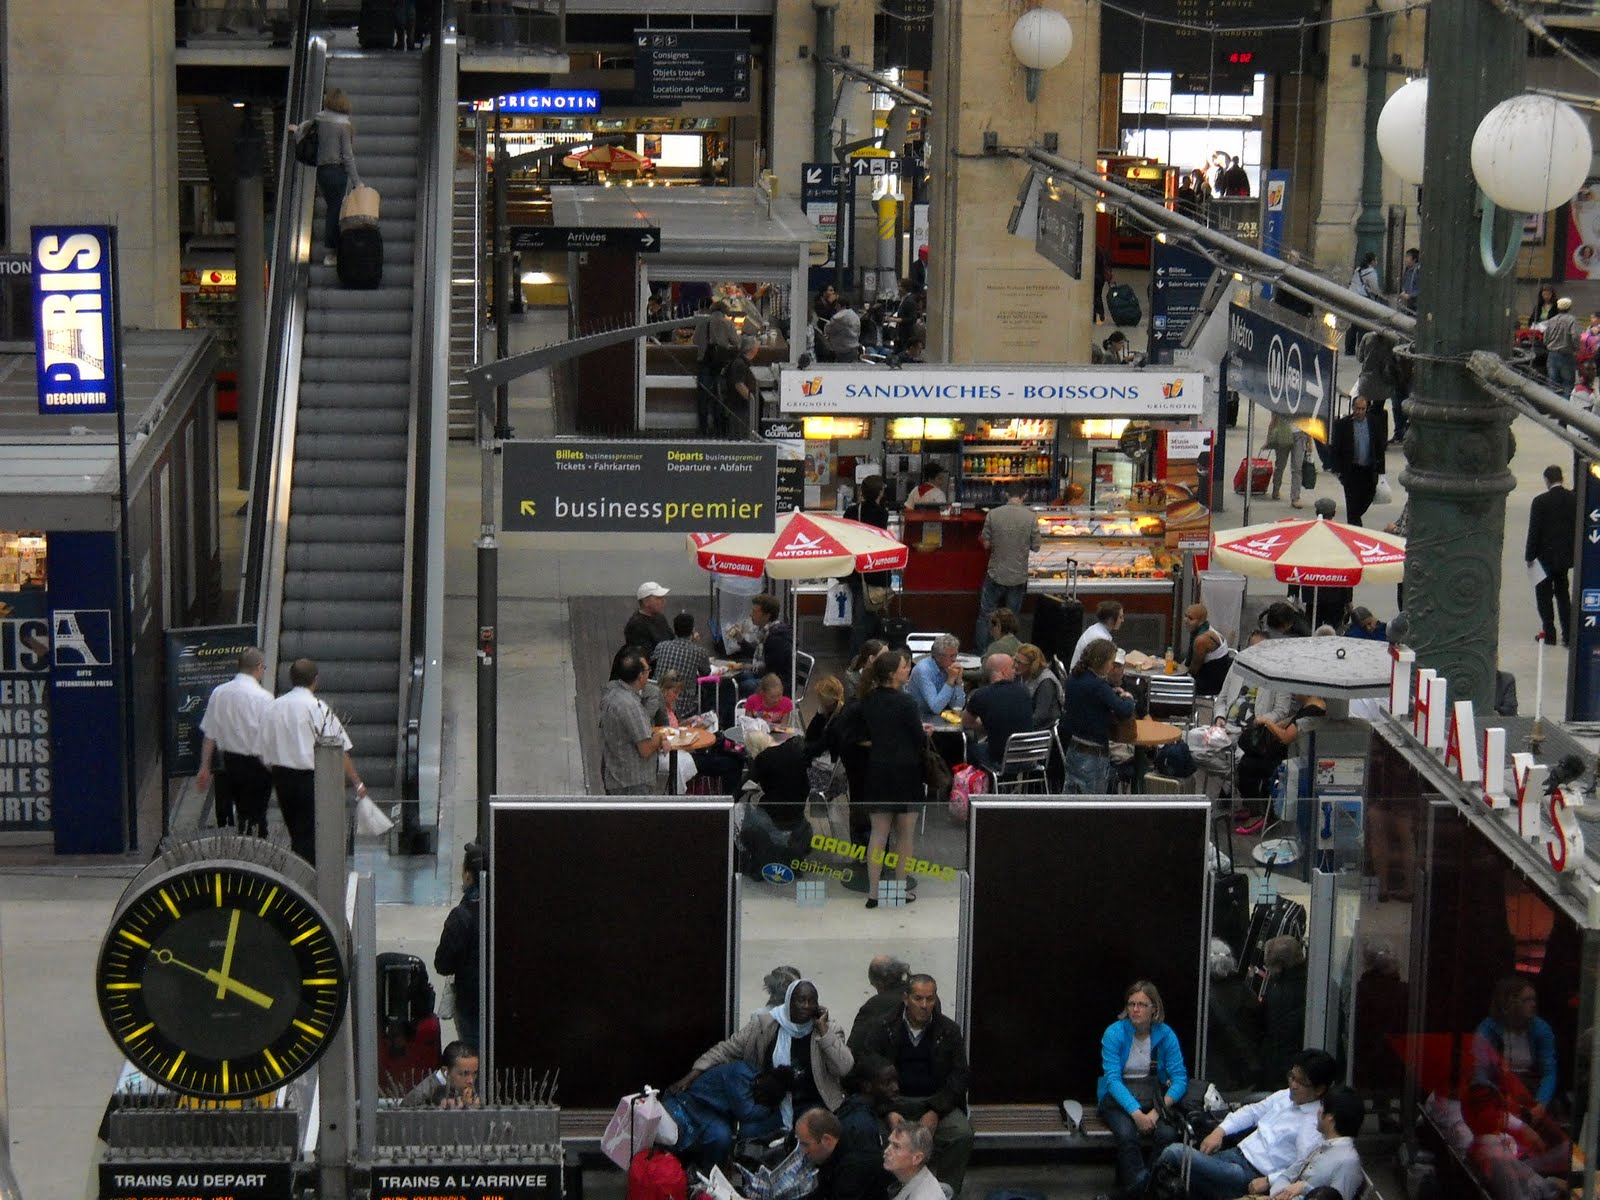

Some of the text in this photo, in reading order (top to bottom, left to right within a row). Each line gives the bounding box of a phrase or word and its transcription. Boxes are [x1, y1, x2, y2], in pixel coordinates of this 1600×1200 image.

[652, 51, 690, 61] Consignes
[652, 68, 677, 78] Objets
[652, 85, 724, 93] Location de voitures
[498, 95, 597, 108] GRIGNOTIN
[567, 232, 607, 241] Arrivées
[0, 261, 32, 274] TION
[1231, 313, 1254, 351] Métro
[845, 384, 1001, 399] SANDWICHES
[1024, 385, 1139, 400] BOISSONS
[46, 392, 107, 406] DECOUVRIR
[765, 429, 801, 437] Gourmand
[771, 424, 788, 432] Café
[556, 450, 643, 461] Billets businesspremier
[667, 450, 763, 462] Départs businesspremier
[556, 462, 641, 471] Tickets Fahrkarten
[667, 463, 752, 472] Departure Abfahrt
[555, 497, 763, 524] businesspremier
[775, 549, 834, 557] AUTOGRILL
[719, 562, 754, 572] AUTOGRILL
[1304, 573, 1348, 582] AUTOGRILL
[198, 646, 249, 656] eurostar
[0, 680, 46, 704] ERY
[1388, 644, 1585, 873] THALYS
[115, 1174, 267, 1187] TRAINS AU DEPART
[379, 1175, 547, 1188] TRAINS A L'ARRIVEE
